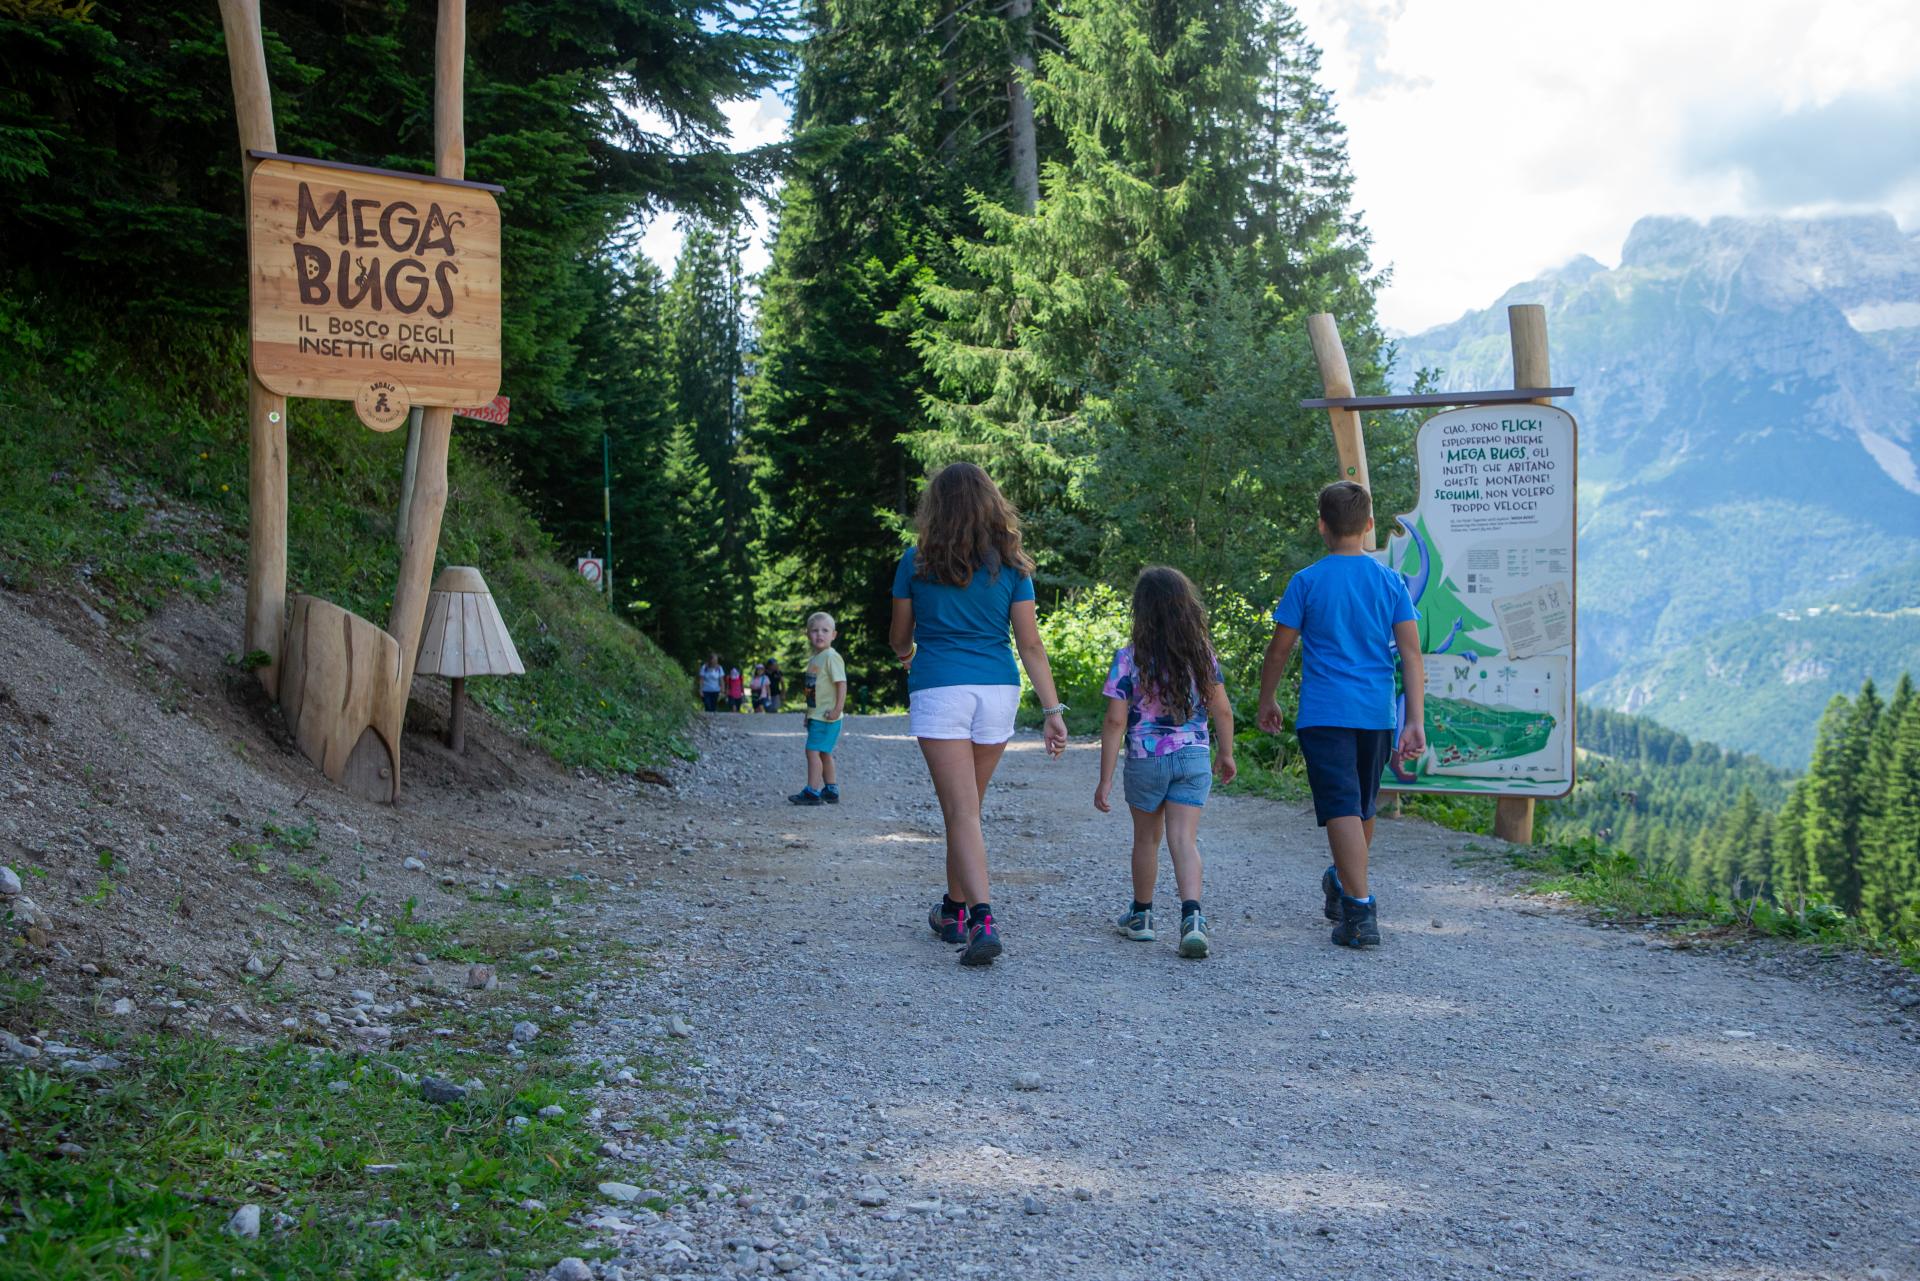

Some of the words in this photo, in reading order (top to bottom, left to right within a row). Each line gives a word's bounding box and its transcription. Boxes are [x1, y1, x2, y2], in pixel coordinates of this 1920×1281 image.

[296, 181, 457, 256] MEGA
[292, 242, 459, 319] BUGS
[299, 315, 317, 333] IL
[329, 317, 389, 338] BOSCO
[398, 324, 454, 345] DEGLI
[299, 336, 374, 358] INSETTI
[381, 344, 455, 366] GIGANTI
[1471, 422, 1498, 432] SONO
[1502, 418, 1542, 432] FLICK!
[1442, 436, 1501, 447] ESPLOREREMO
[1504, 435, 1544, 445] INSIEME
[1447, 447, 1487, 463] MEGA
[1490, 446, 1530, 460] BUGS,
[1532, 447, 1549, 457] GLI
[1442, 463, 1478, 475] INSETTI
[1483, 464, 1501, 472] CHE
[1507, 460, 1555, 472] ABITANO
[1444, 476, 1478, 487] QUESTE
[1486, 474, 1550, 486] MONTAGNE!
[1434, 489, 1483, 501] SEGUIMI,
[1486, 489, 1508, 499] NON
[1451, 503, 1490, 513] TROPPO
[1494, 501, 1537, 511] VELOCE!
